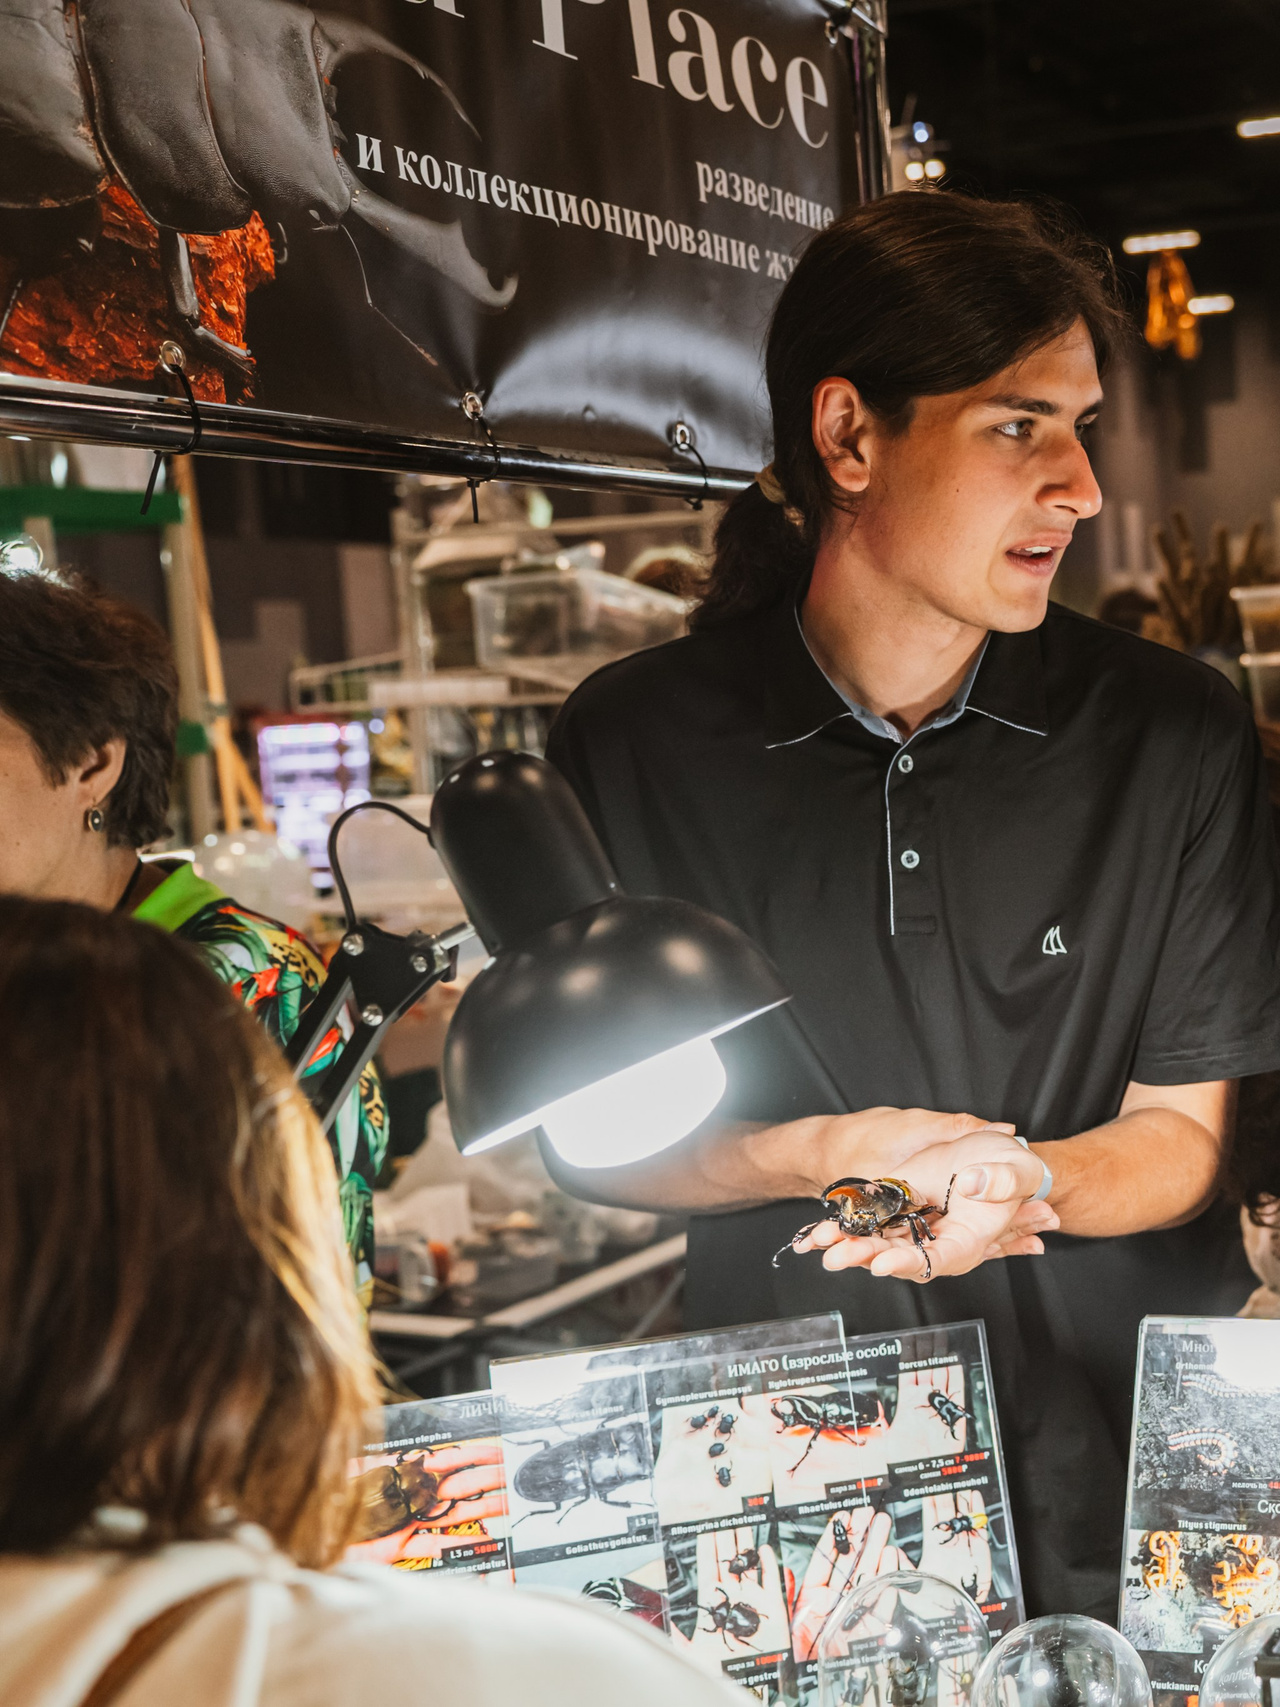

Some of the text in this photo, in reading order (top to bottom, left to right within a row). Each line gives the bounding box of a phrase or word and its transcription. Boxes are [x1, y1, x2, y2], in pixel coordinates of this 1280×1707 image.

[533, 0, 829, 149] lace
[355, 133, 385, 174] и
[394, 144, 761, 274] коллекционирование
[695, 160, 835, 232] разведение
[727, 1338, 902, 1378] ИМАГО (взрослые особи)
[415, 1430, 453, 1447] elephas
[720, 1512, 767, 1528] dichotoma
[565, 1540, 610, 1557] Goliathus
